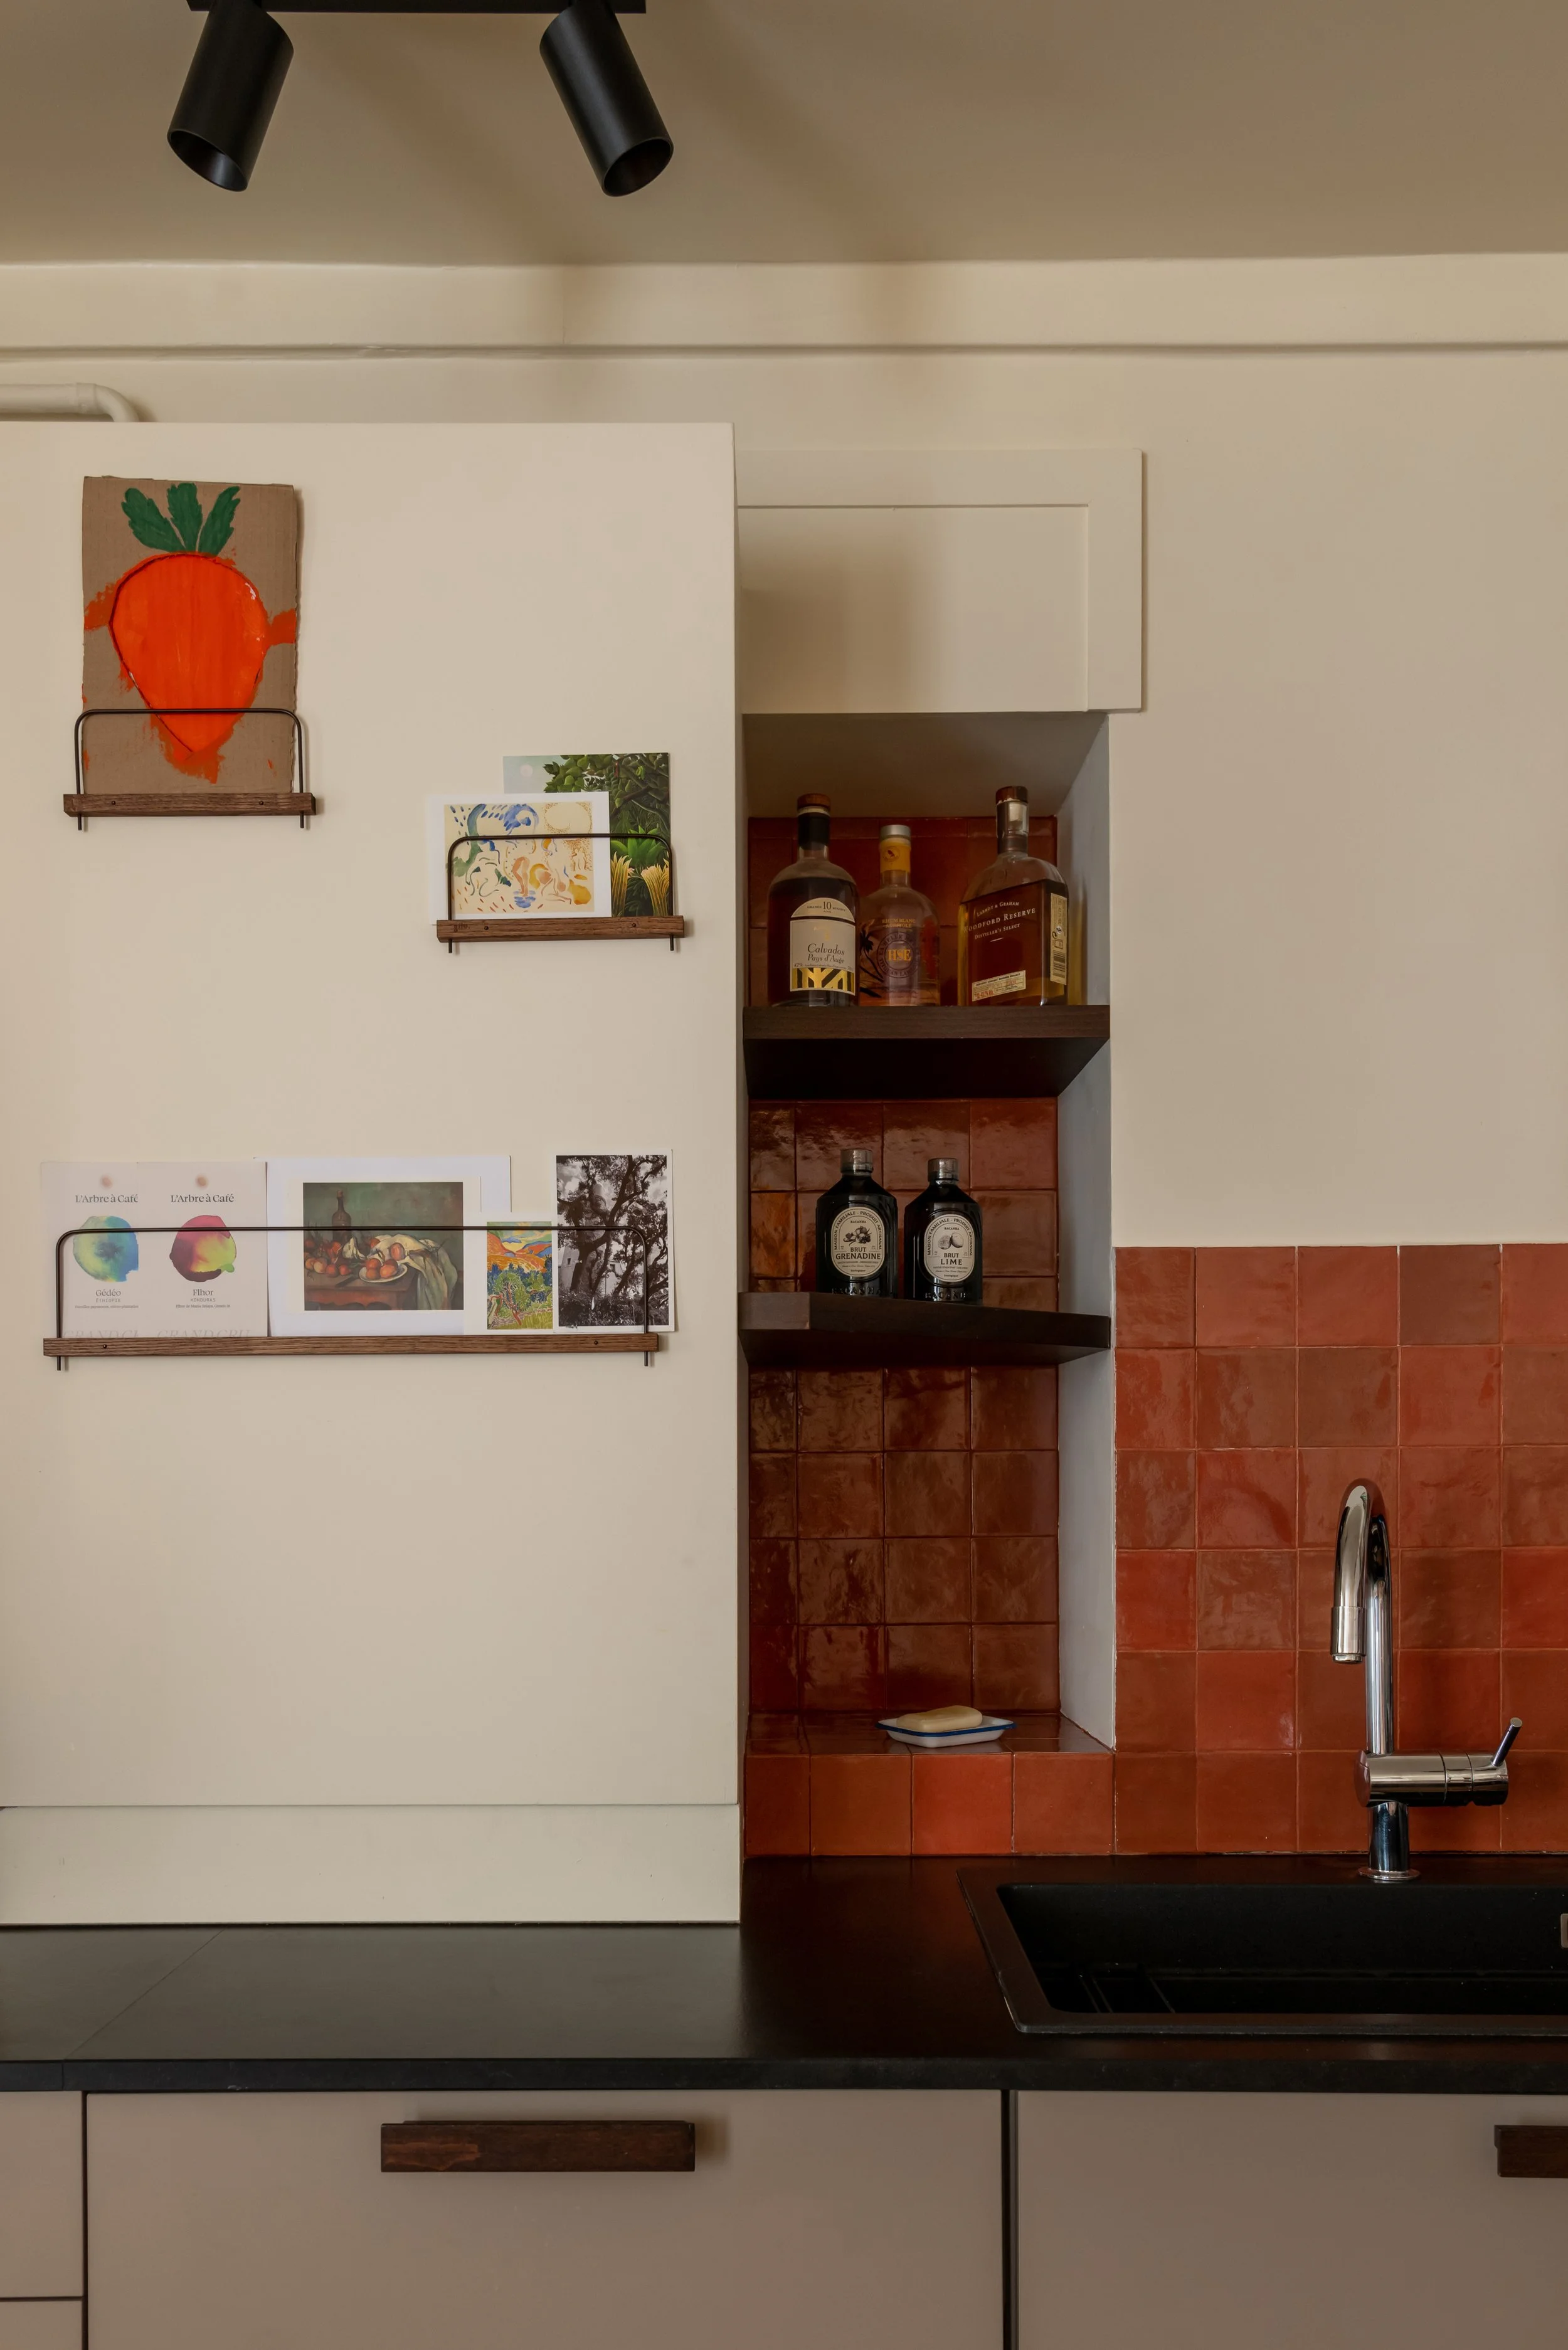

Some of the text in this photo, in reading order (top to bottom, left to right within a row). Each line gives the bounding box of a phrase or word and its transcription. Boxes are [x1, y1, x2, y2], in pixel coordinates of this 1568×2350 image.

[823, 901, 832, 910] 10
[963, 918, 1001, 933] WOODFORD
[1004, 908, 1036, 921] RESERVE
[1004, 923, 1020, 931] SELECT
[807, 943, 845, 956] Calvados
[887, 949, 911, 961] HSE
[807, 953, 845, 964] Pays d'Auge
[75, 1194, 139, 1203] L'Arbre à Café
[171, 1194, 235, 1203] L'Arbre à Café
[835, 1211, 856, 1229] FAMILIALE
[860, 1210, 878, 1224] PRODUIT
[929, 1218, 949, 1235] FAMILIALE
[953, 1218, 970, 1231] PRODUIT
